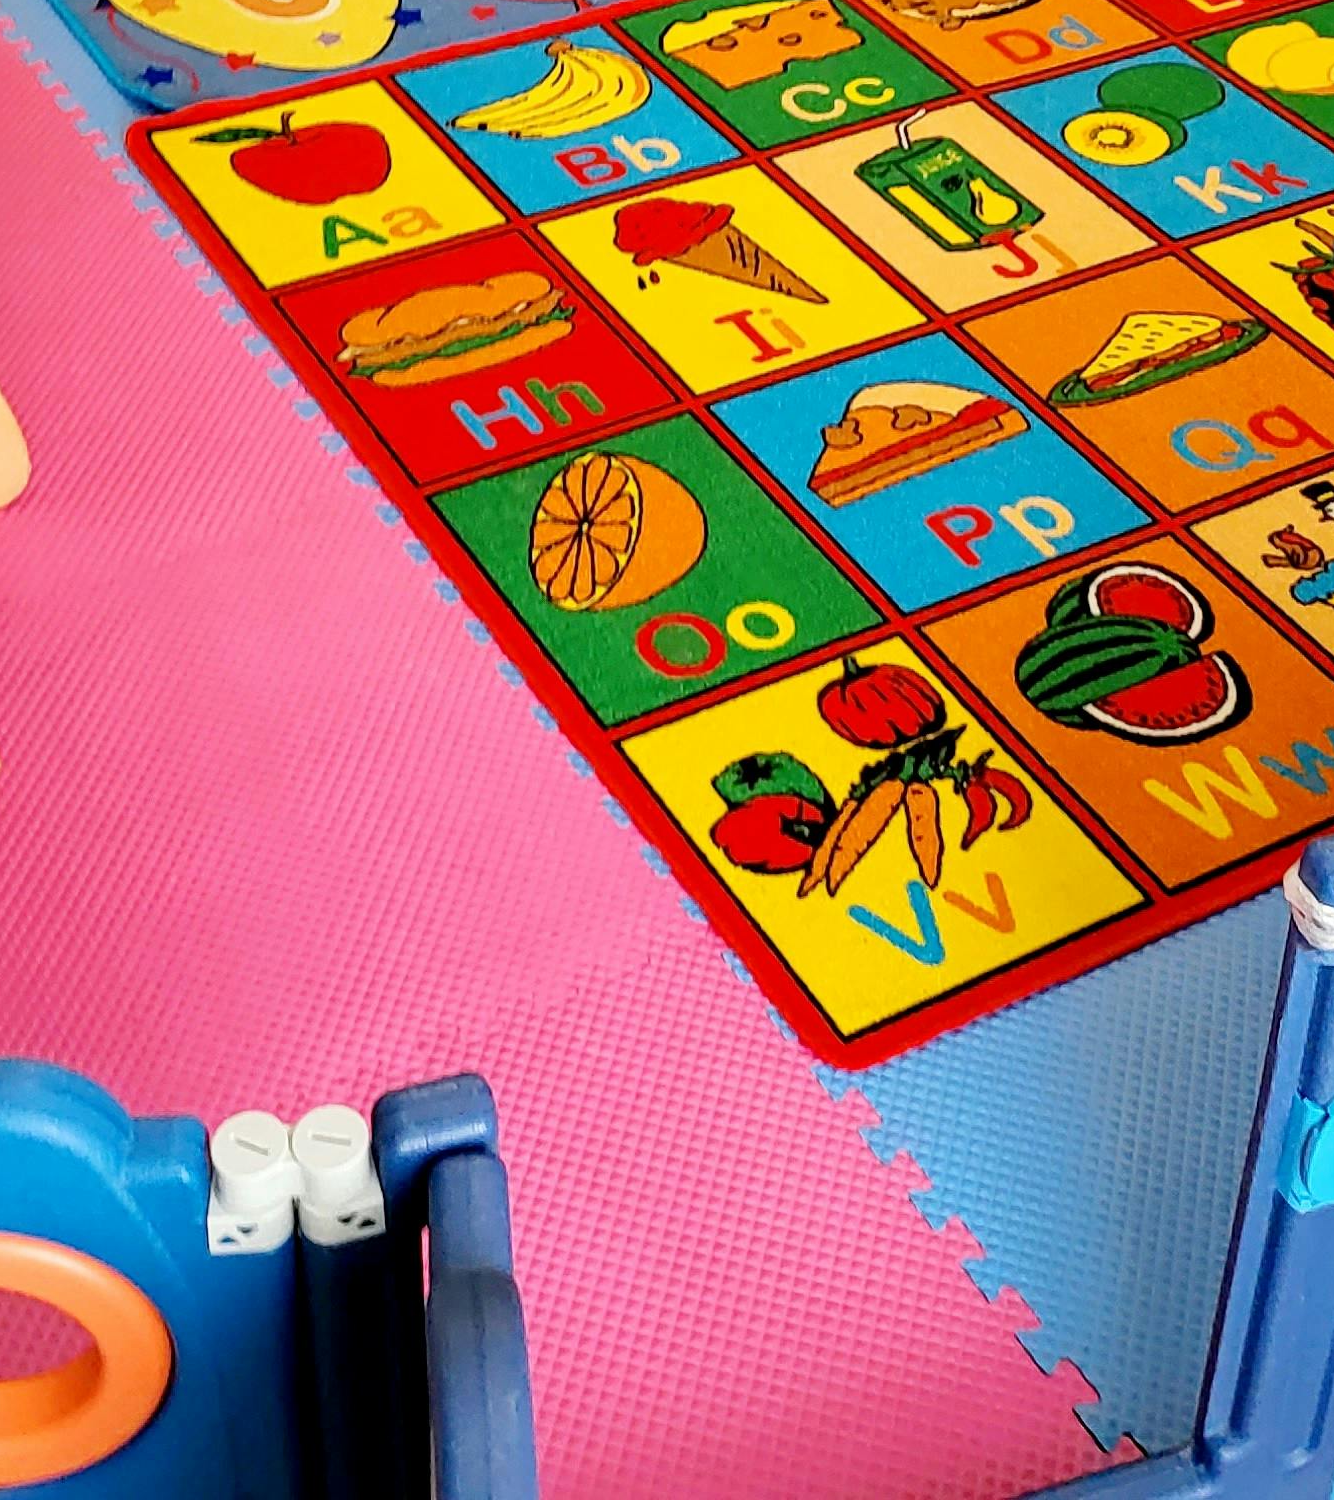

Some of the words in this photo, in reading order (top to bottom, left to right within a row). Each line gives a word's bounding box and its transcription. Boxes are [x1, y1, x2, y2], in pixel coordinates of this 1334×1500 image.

[984, 13, 1103, 65] Dd
[780, 76, 895, 122] Cc
[554, 135, 682, 188] Bb
[1175, 159, 1308, 214] Kk
[322, 204, 442, 258] Aa
[714, 307, 806, 362] Ii
[450, 377, 606, 450] Hh
[1168, 403, 1334, 472] Qq
[923, 492, 1076, 567] Pp
[635, 601, 796, 680] Oo
[847, 871, 1017, 966] Vv
